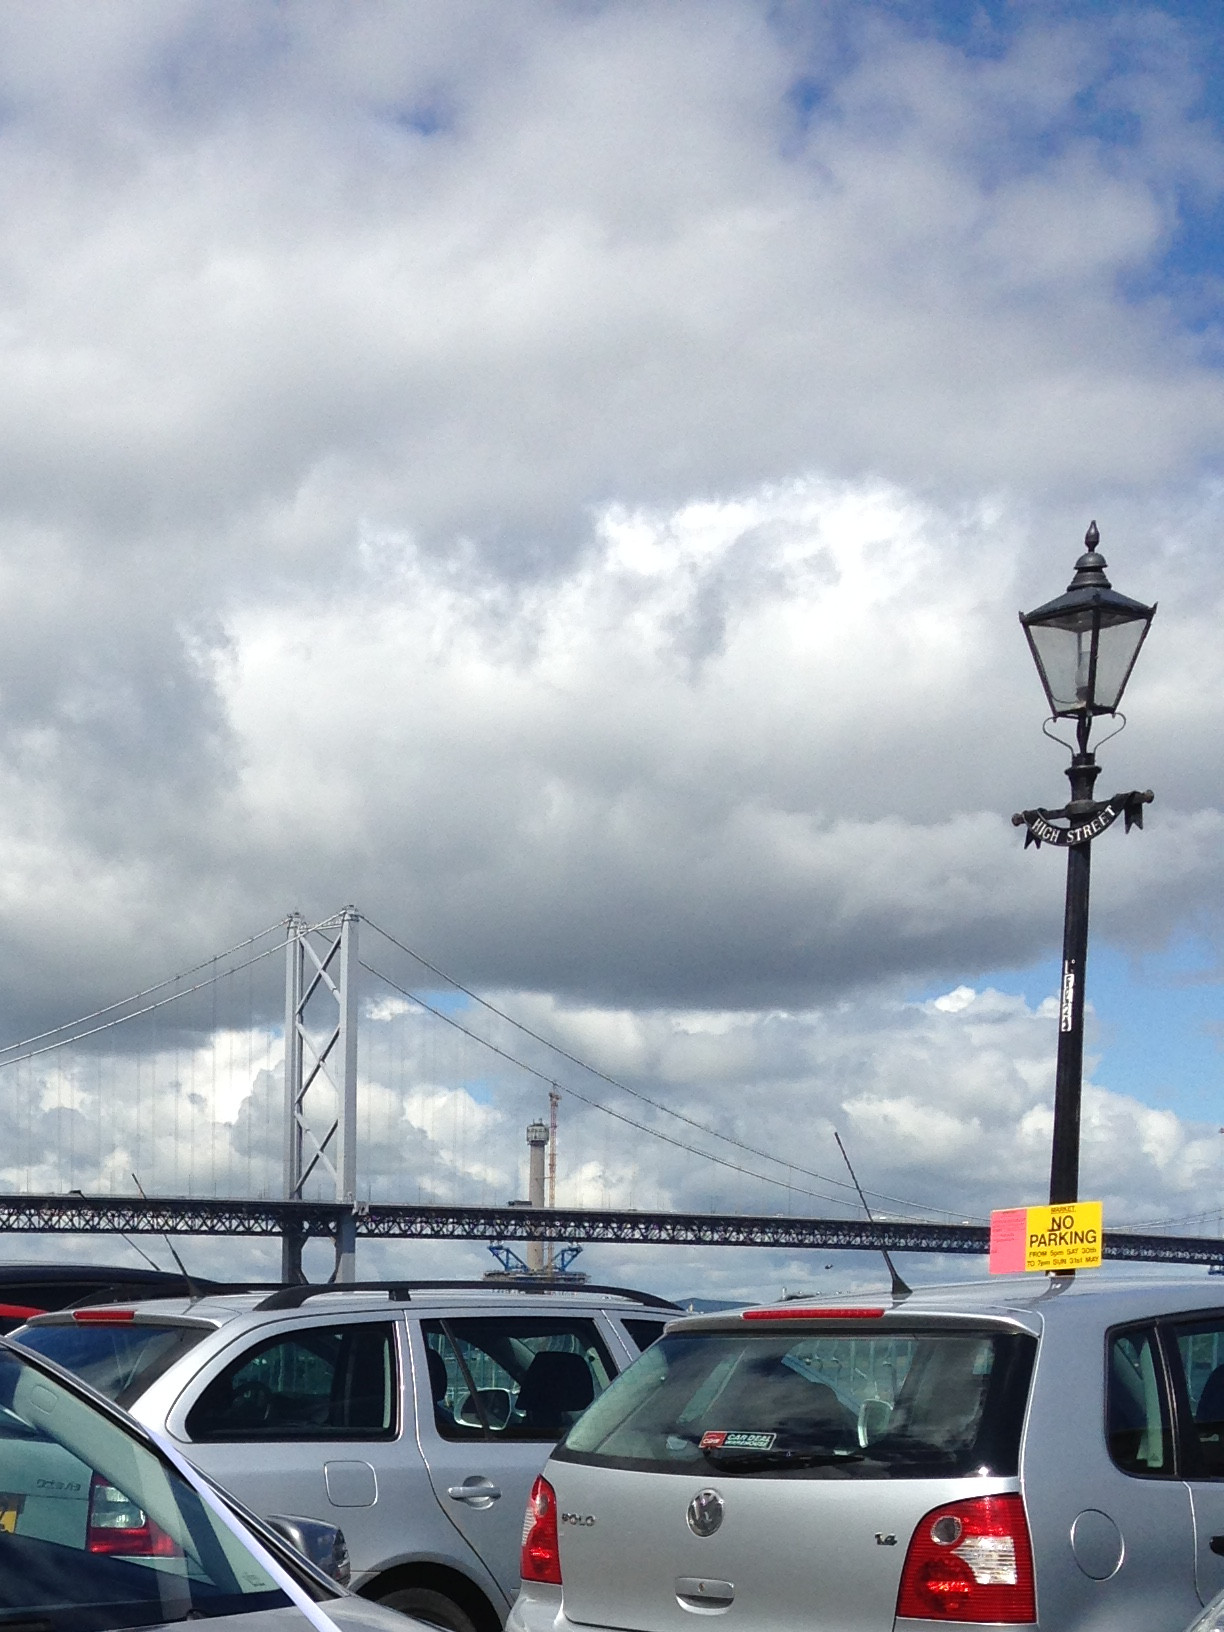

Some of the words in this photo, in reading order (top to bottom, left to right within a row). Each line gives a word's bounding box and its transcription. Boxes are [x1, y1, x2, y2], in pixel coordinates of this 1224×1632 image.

[1030, 818, 1061, 843] HIGH
[1066, 804, 1116, 843] STREET
[1051, 1215, 1074, 1231] NO
[1030, 1229, 1097, 1248] PARKING
[727, 1433, 748, 1441] CAR
[747, 1434, 772, 1442] DEAL
[561, 1512, 595, 1527] POLO
